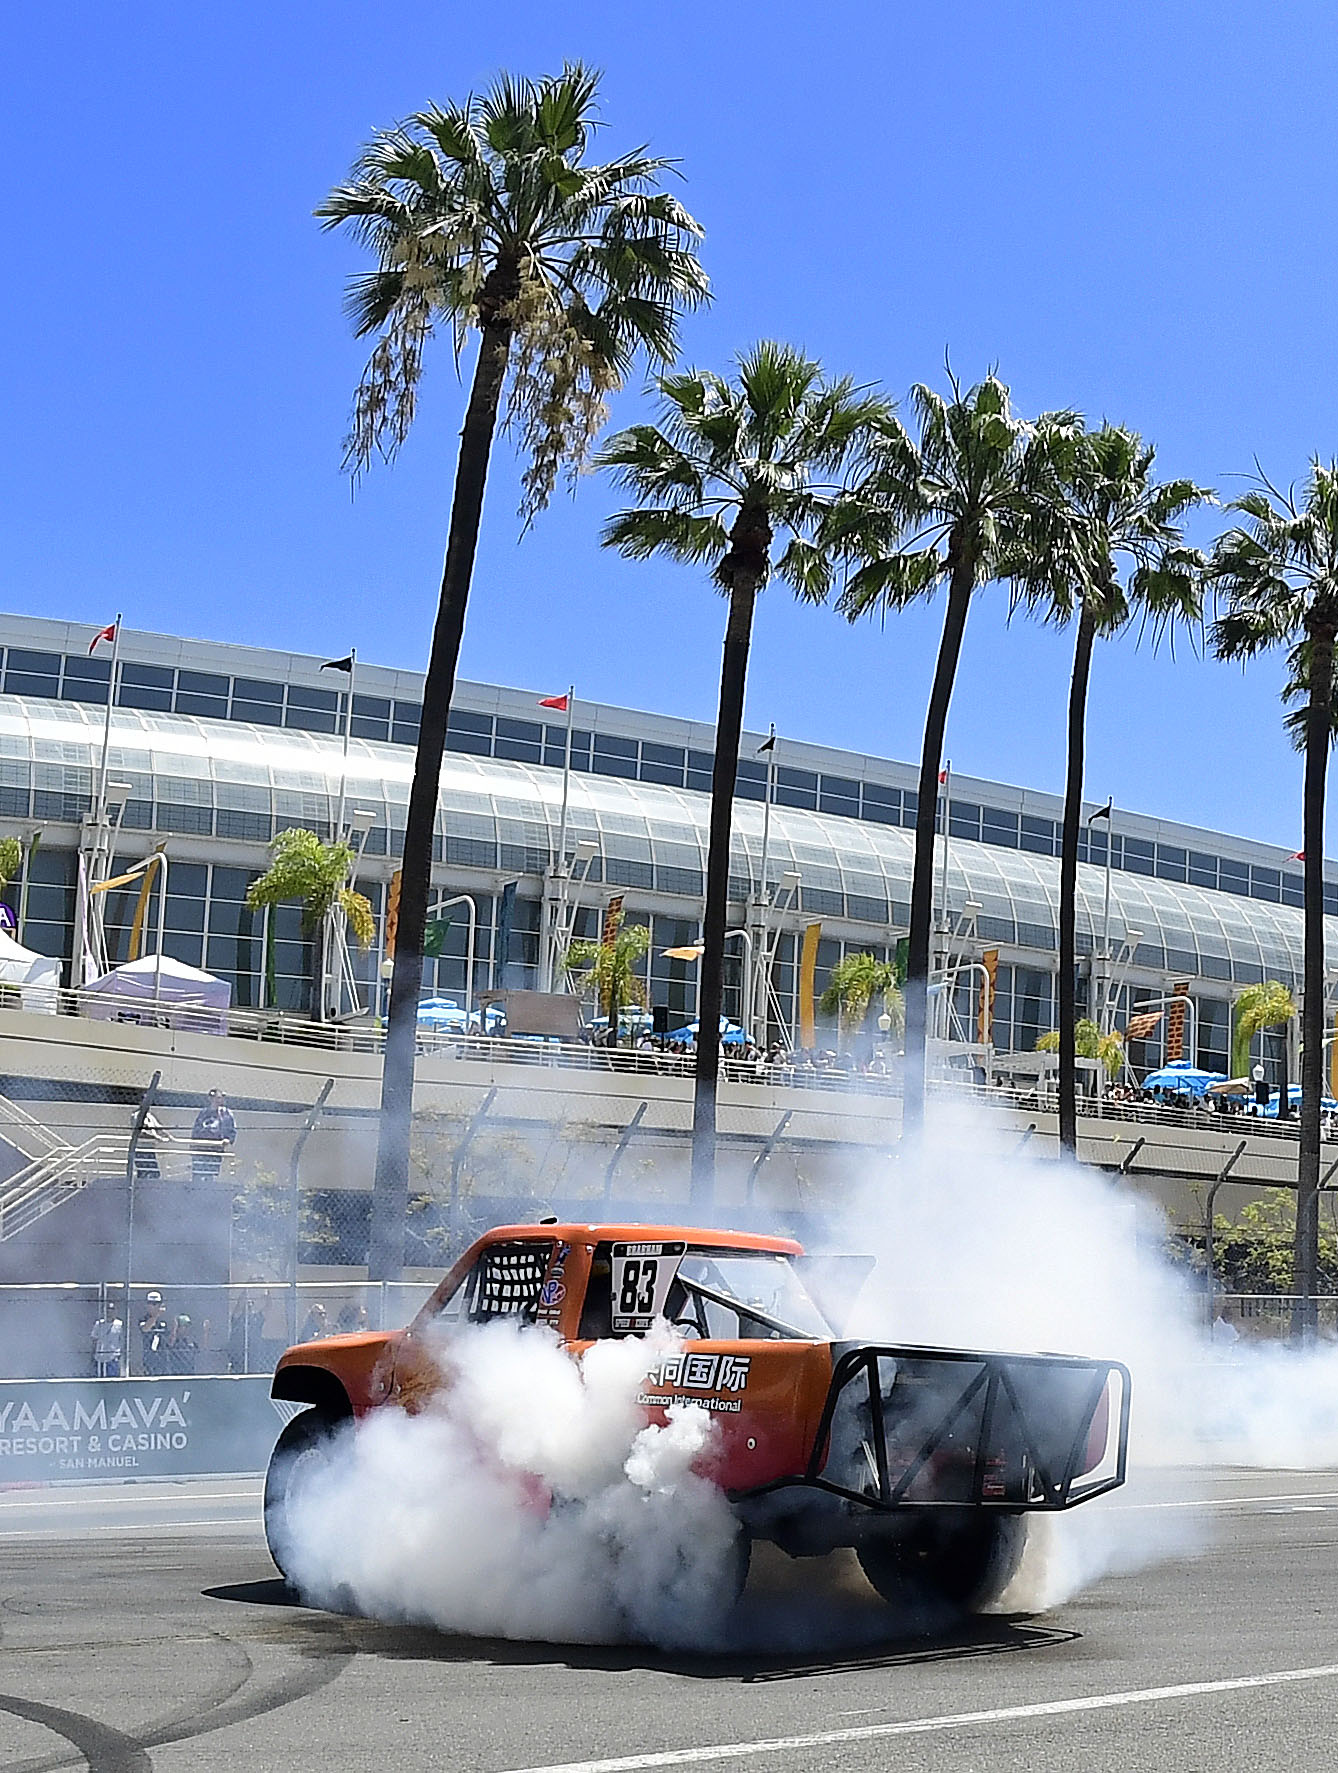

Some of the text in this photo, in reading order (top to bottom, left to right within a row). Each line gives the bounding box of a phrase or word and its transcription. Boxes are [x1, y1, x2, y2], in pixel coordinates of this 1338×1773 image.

[620, 1260, 658, 1313] 83
[637, 1392, 672, 1404] Common
[0, 1432, 188, 1455] RESORT & CASINO
[60, 1455, 139, 1469] SAN MANUEL
